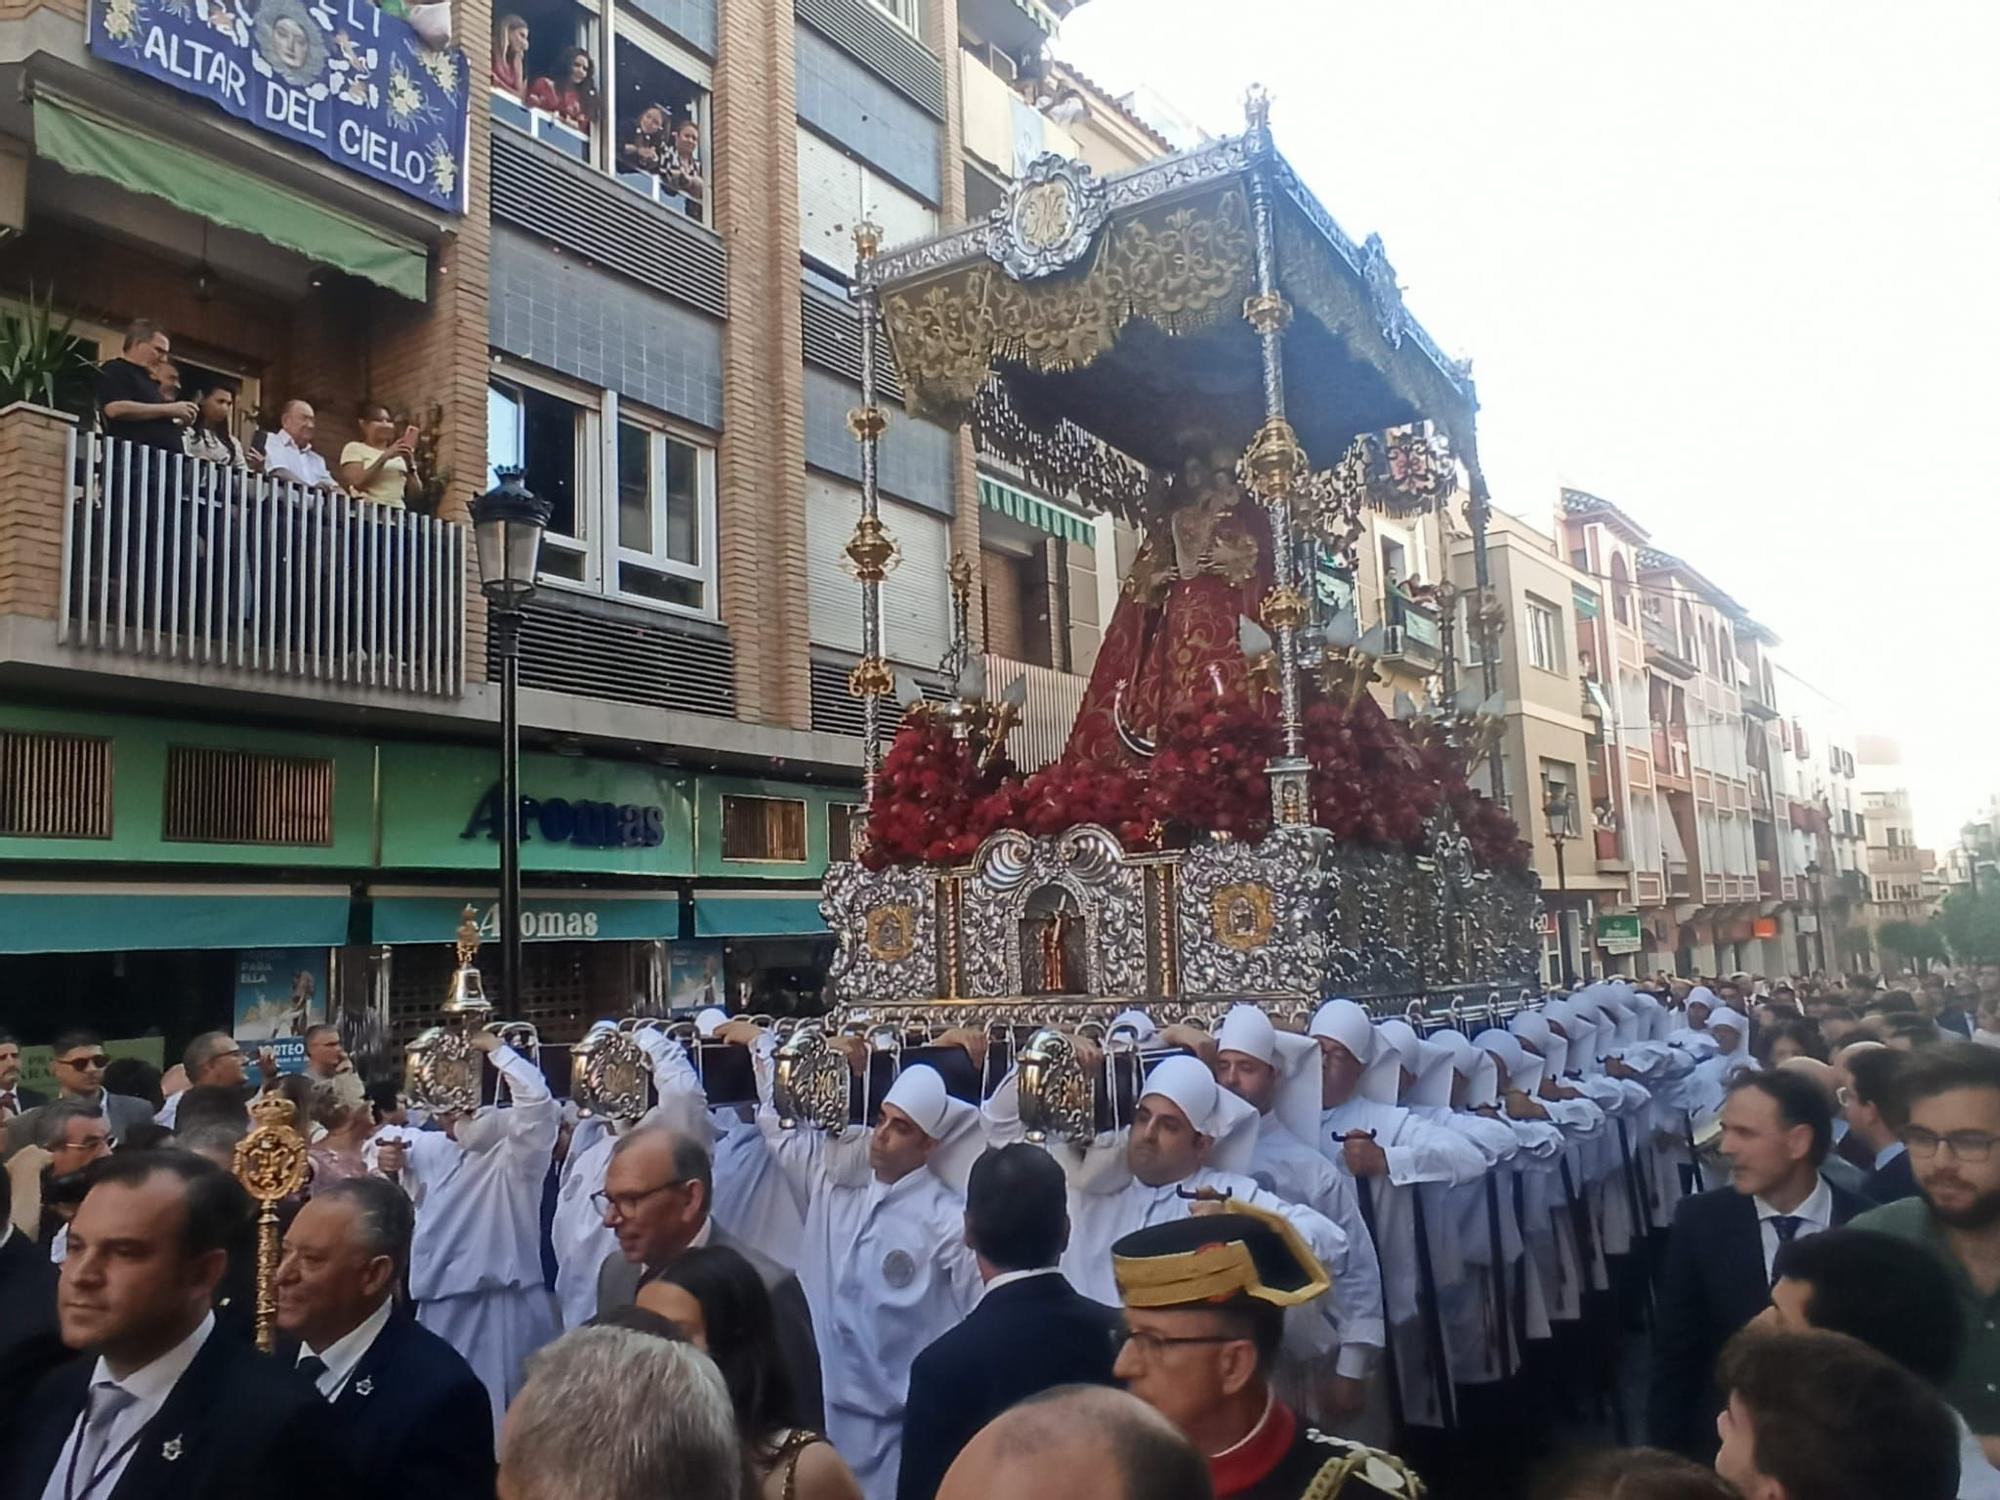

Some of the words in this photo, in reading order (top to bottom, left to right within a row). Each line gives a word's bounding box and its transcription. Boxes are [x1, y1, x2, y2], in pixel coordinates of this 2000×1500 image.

[144, 26, 246, 106] ALTAR
[265, 80, 327, 138] DEL
[459, 778, 665, 848] Aromas
[479, 902, 598, 937] Aomas
[259, 1043, 304, 1056] ORTEO
